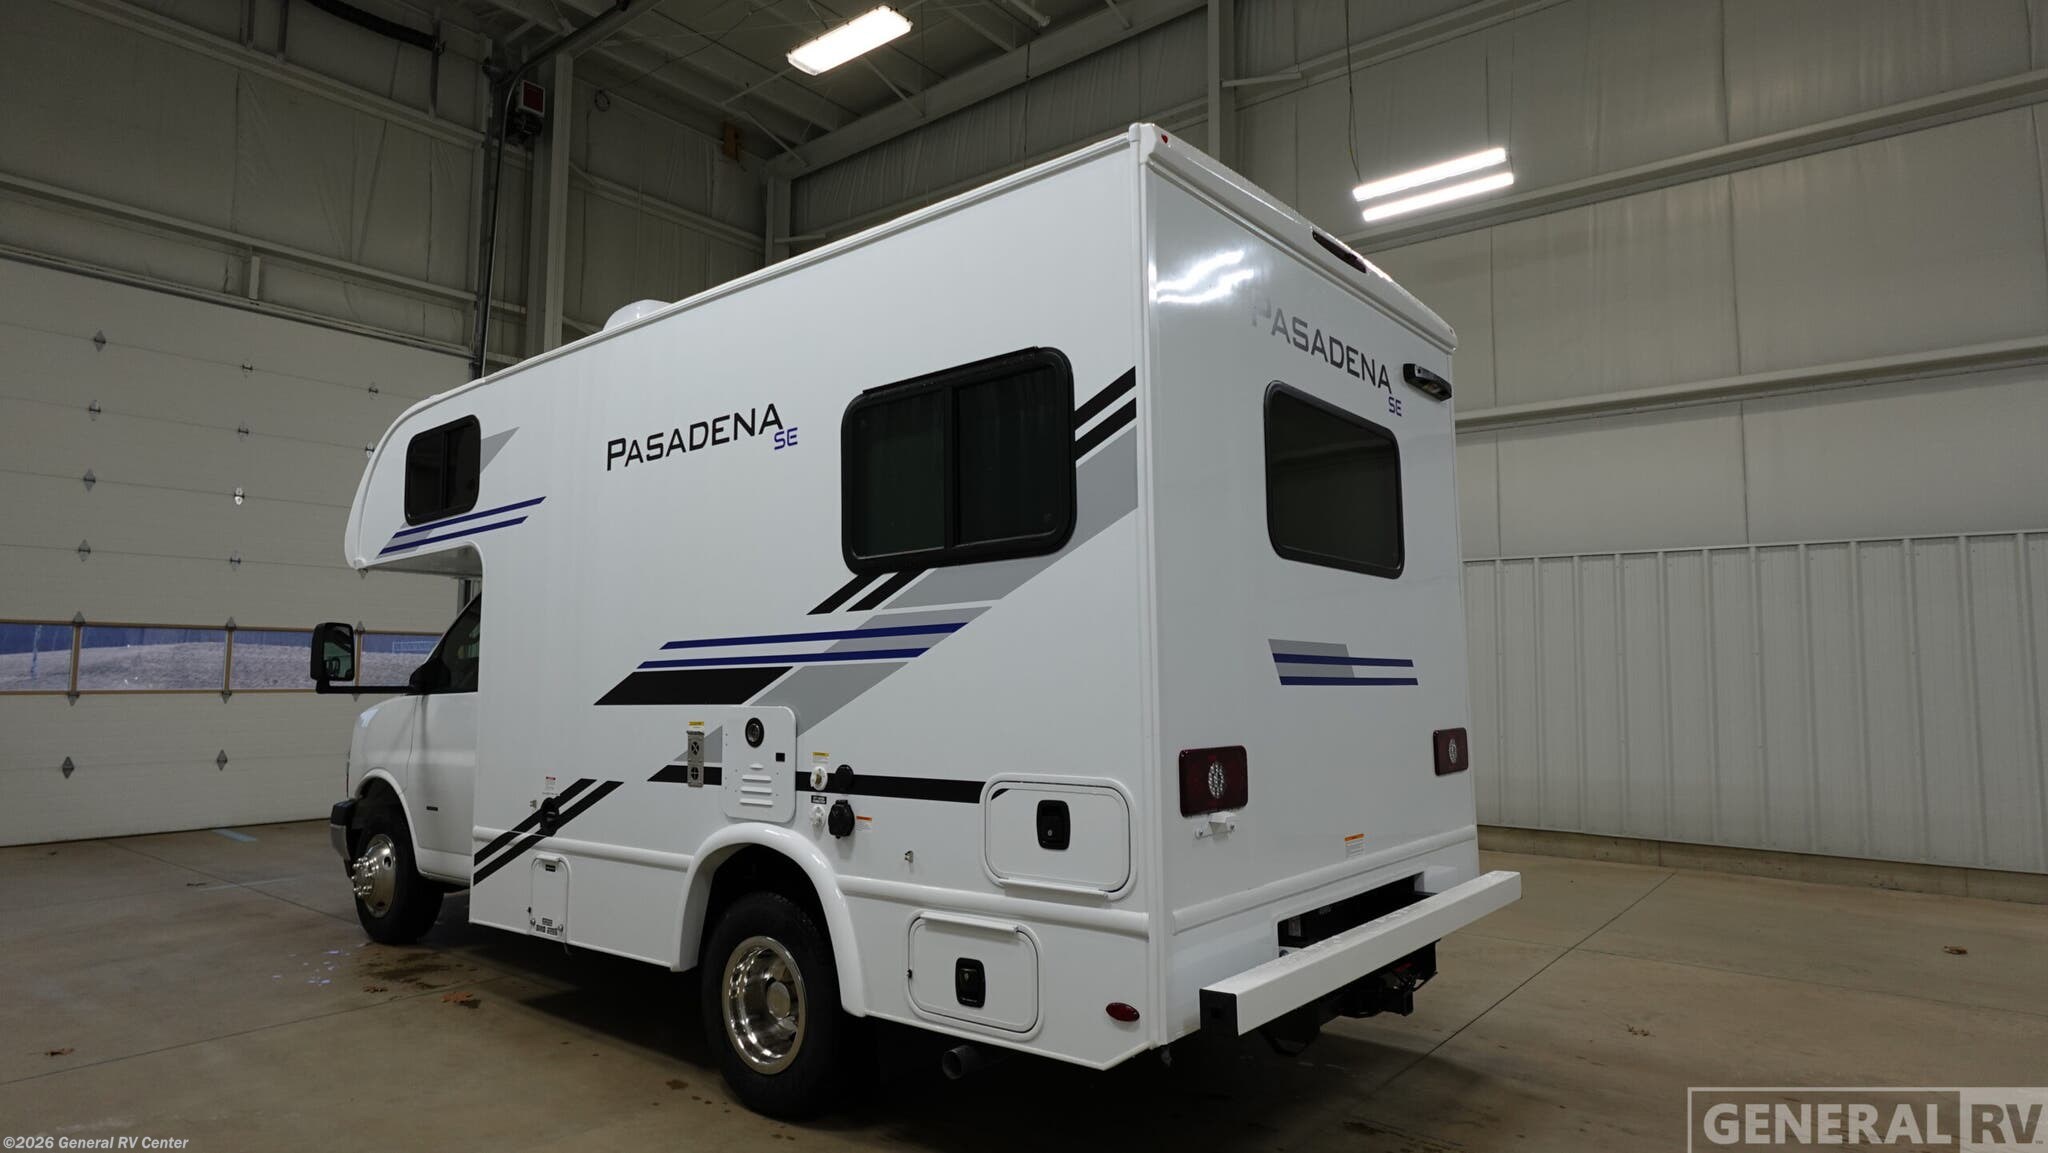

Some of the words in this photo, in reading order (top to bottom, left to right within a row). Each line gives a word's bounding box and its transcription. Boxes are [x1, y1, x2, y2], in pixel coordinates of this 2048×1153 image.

[1250, 296, 1392, 394] PASADENA
[1388, 396, 1403, 417] SE
[606, 403, 784, 471] PASADENA
[773, 427, 799, 450] SE
